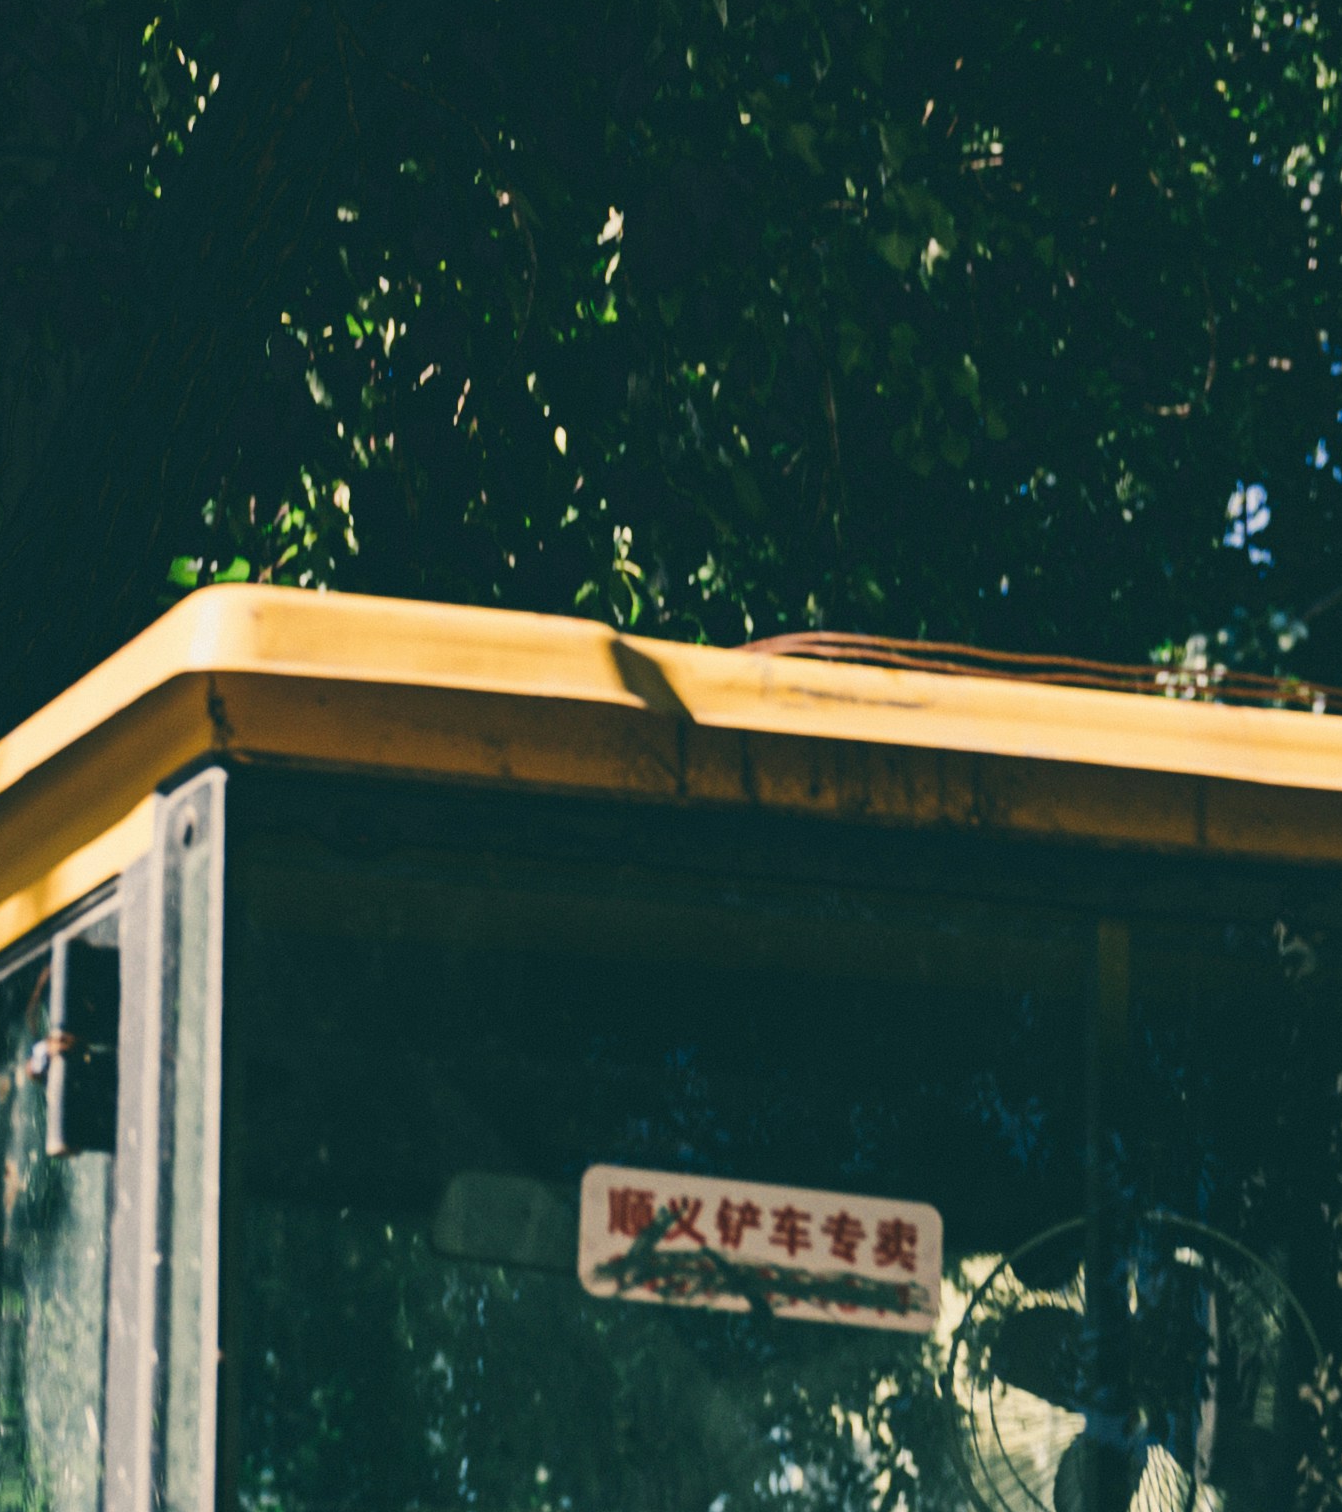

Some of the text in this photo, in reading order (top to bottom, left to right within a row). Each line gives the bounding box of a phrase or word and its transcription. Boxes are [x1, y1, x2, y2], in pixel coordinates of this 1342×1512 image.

[607, 1187, 920, 1274] 顺义铲车专卖
